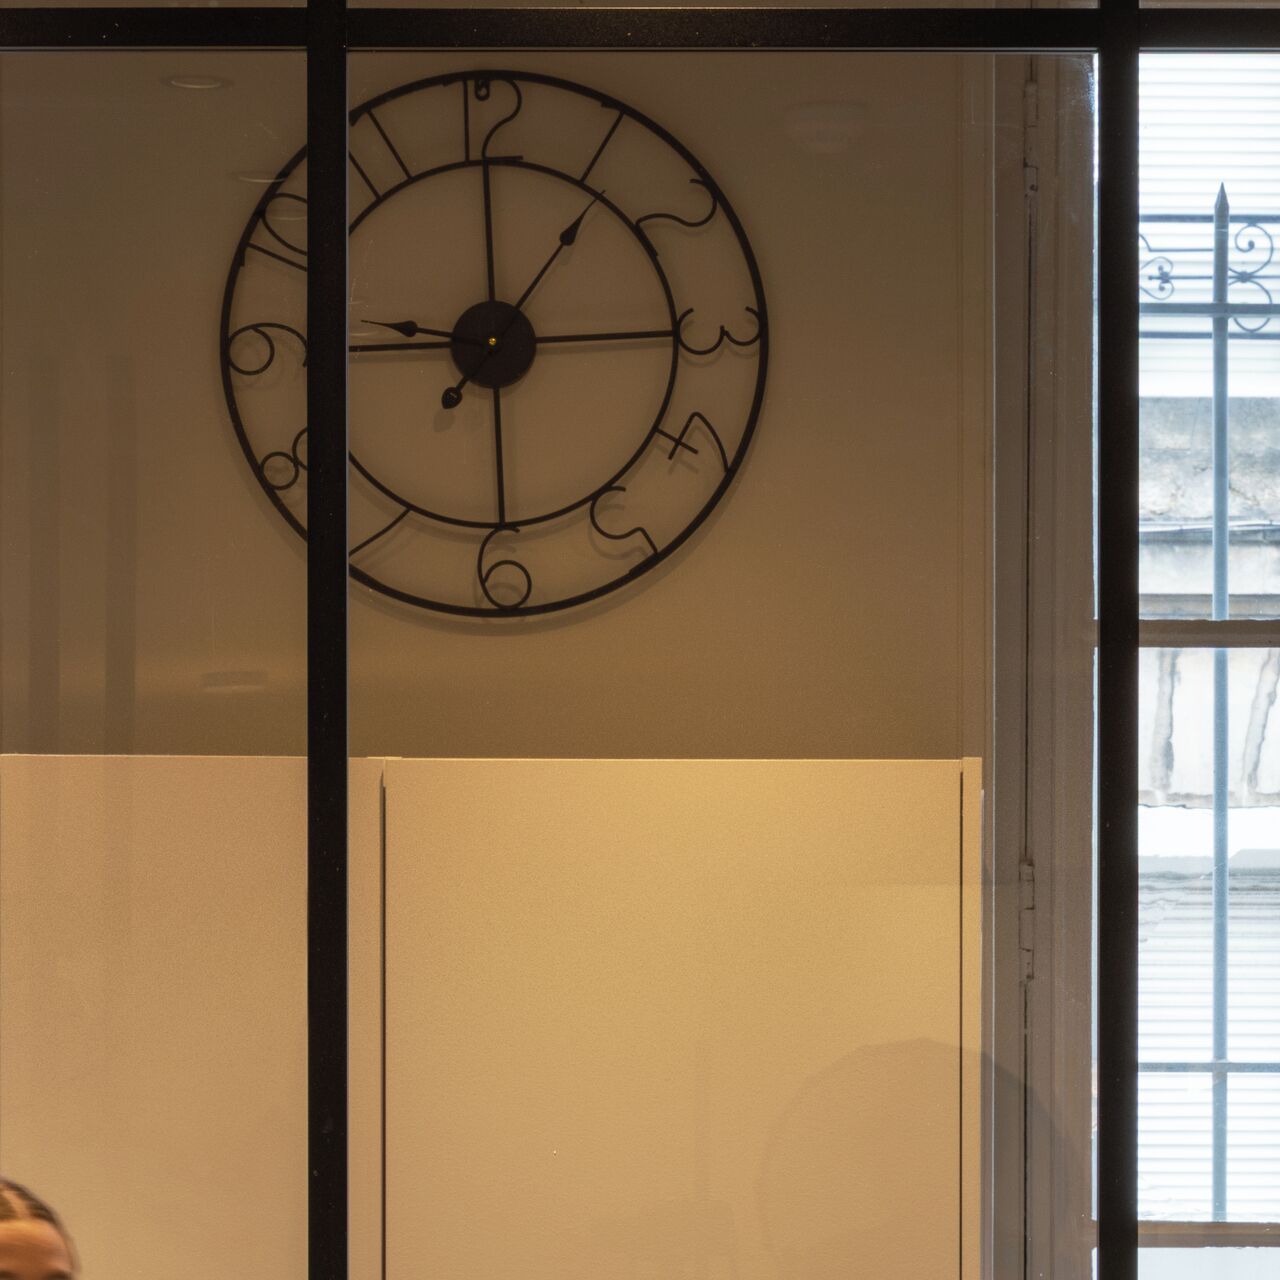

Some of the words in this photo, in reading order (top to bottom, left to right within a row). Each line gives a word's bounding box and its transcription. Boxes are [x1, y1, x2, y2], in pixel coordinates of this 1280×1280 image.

[463, 78, 524, 164] 12
[634, 178, 718, 257] 2
[227, 322, 309, 375] 9
[676, 306, 763, 356] 3
[477, 525, 531, 610] 6
